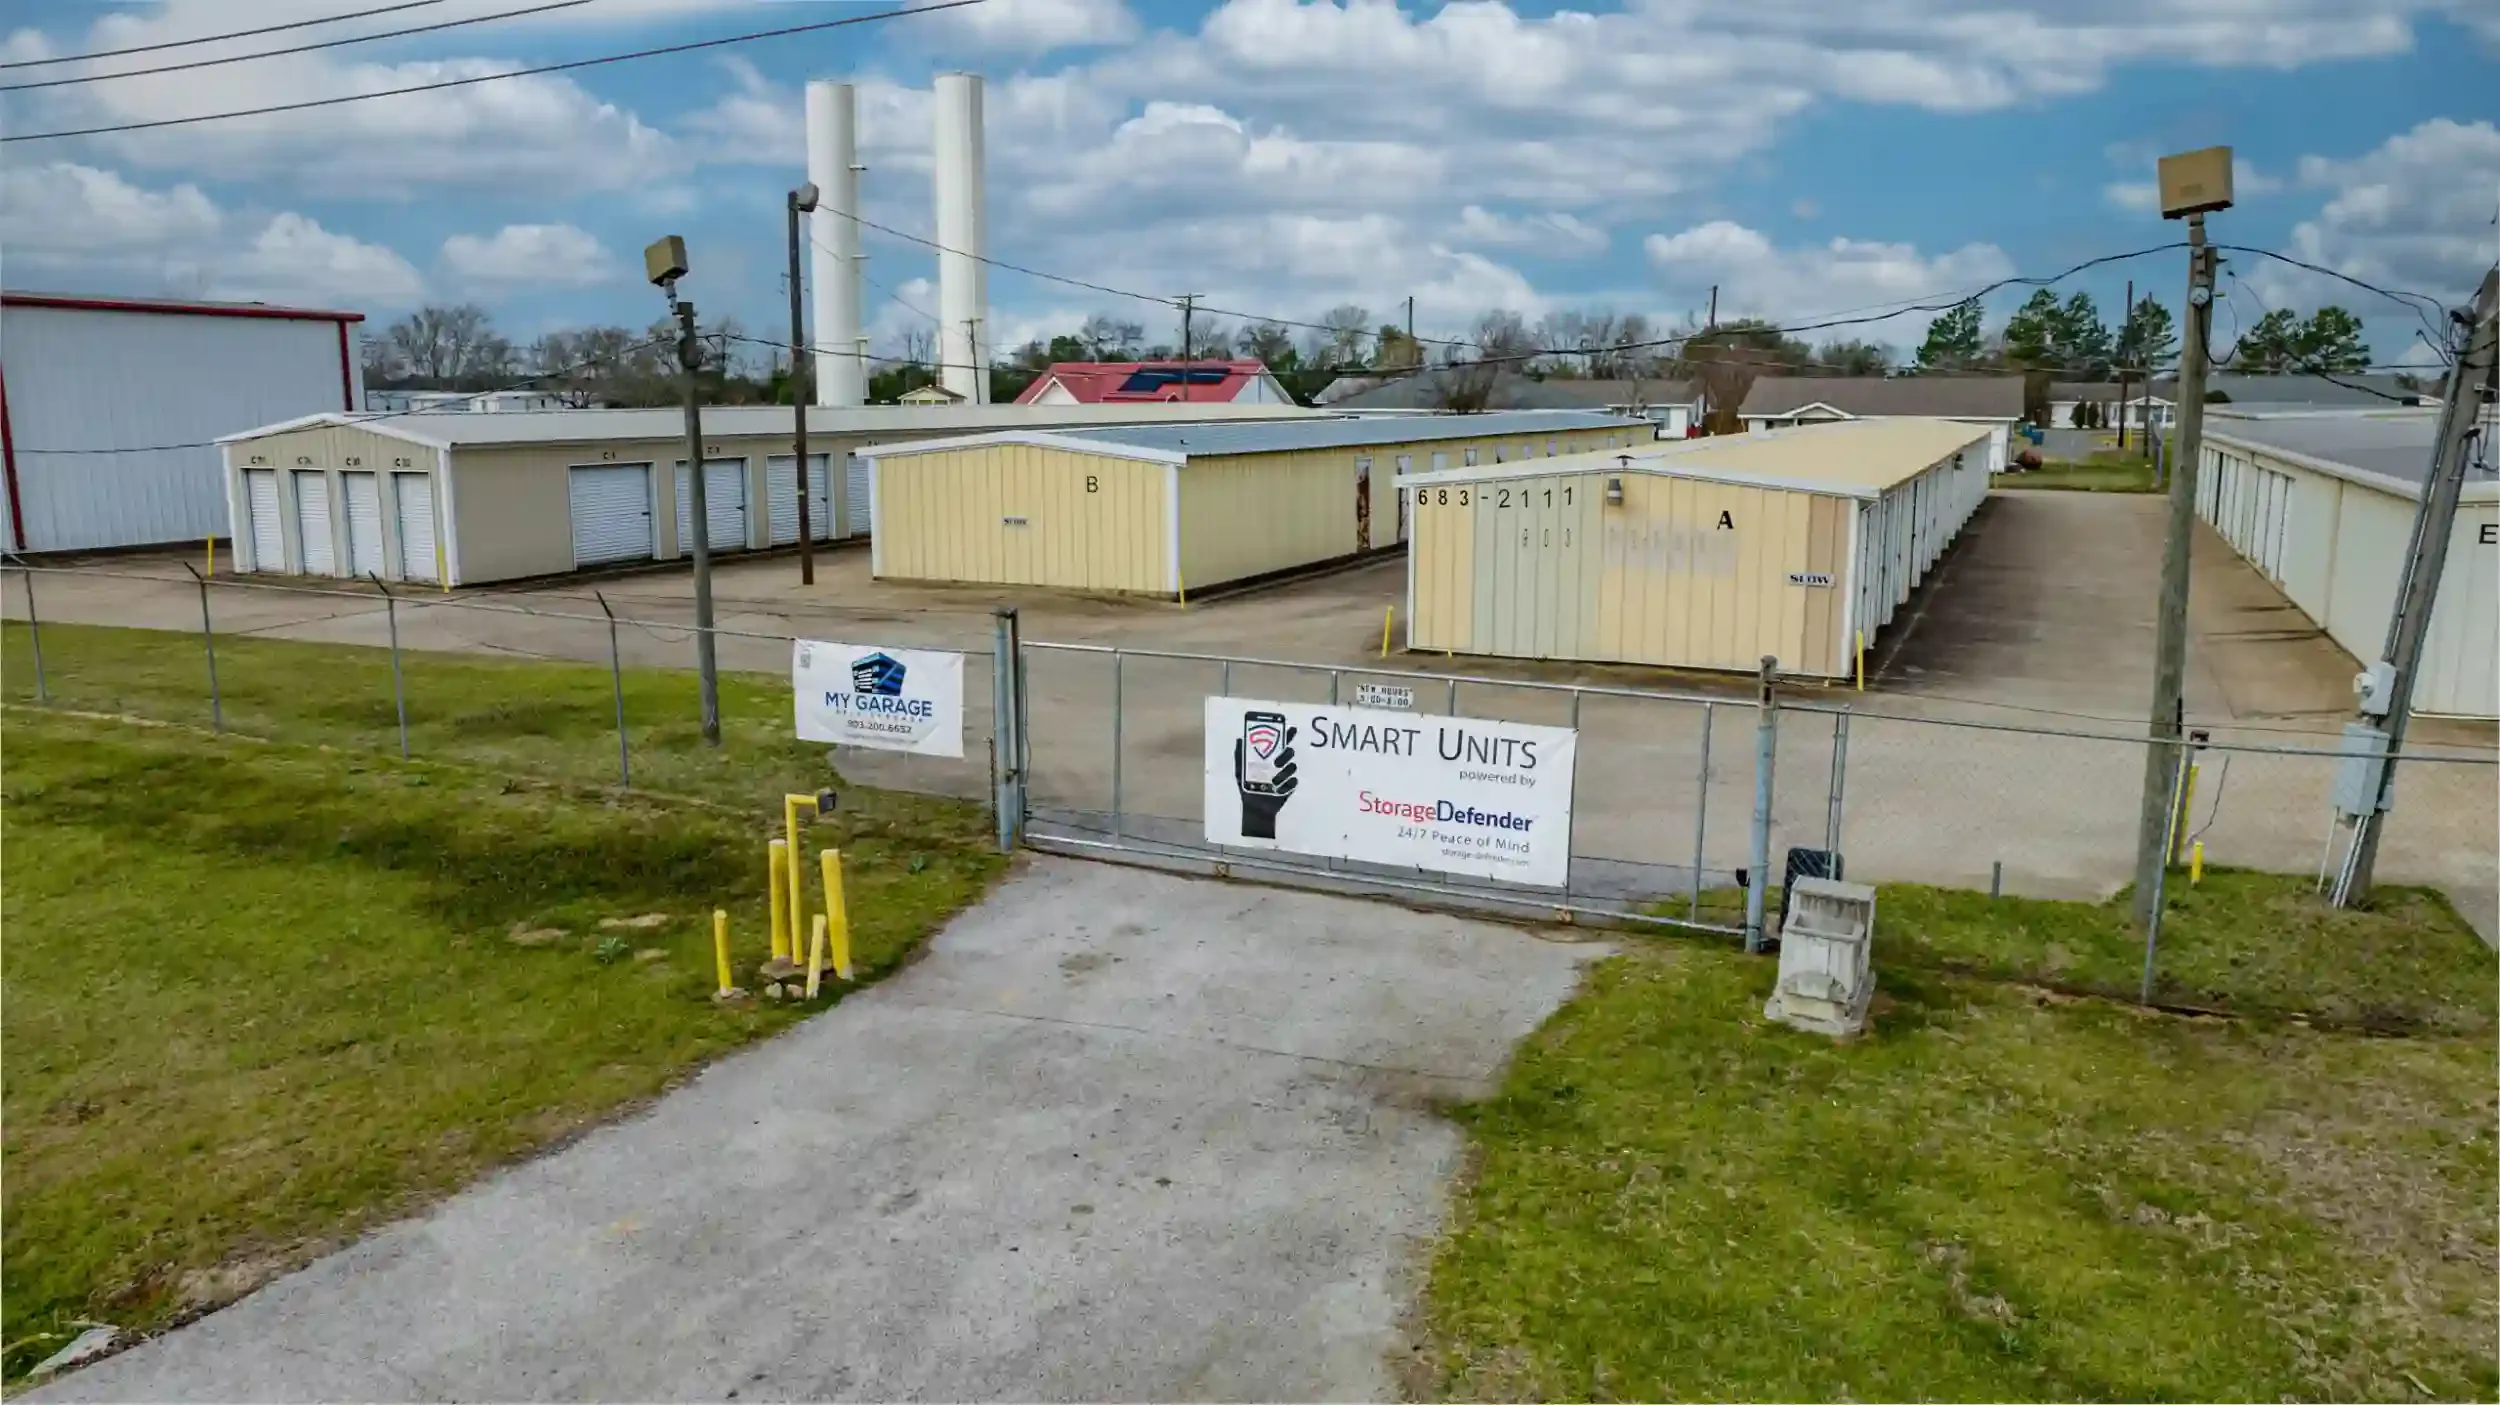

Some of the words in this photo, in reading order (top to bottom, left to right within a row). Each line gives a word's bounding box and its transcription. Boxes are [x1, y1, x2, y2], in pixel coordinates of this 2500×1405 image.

[1086, 475, 1099, 493] B
[1716, 510, 1734, 530] A
[2479, 524, 2499, 544] E
[825, 691, 850, 709] MY
[855, 695, 933, 717] GARAGE
[1310, 715, 1421, 756] SMART
[1438, 727, 1537, 769] UNITS
[1459, 769, 1517, 785] powered
[1520, 773, 1536, 788] by
[1359, 790, 1533, 832] StorageDefender
[1397, 826, 1427, 841] 24/7
[1431, 829, 1472, 846] Peace
[1476, 836, 1491, 848] of
[1495, 837, 1531, 854] Mind
